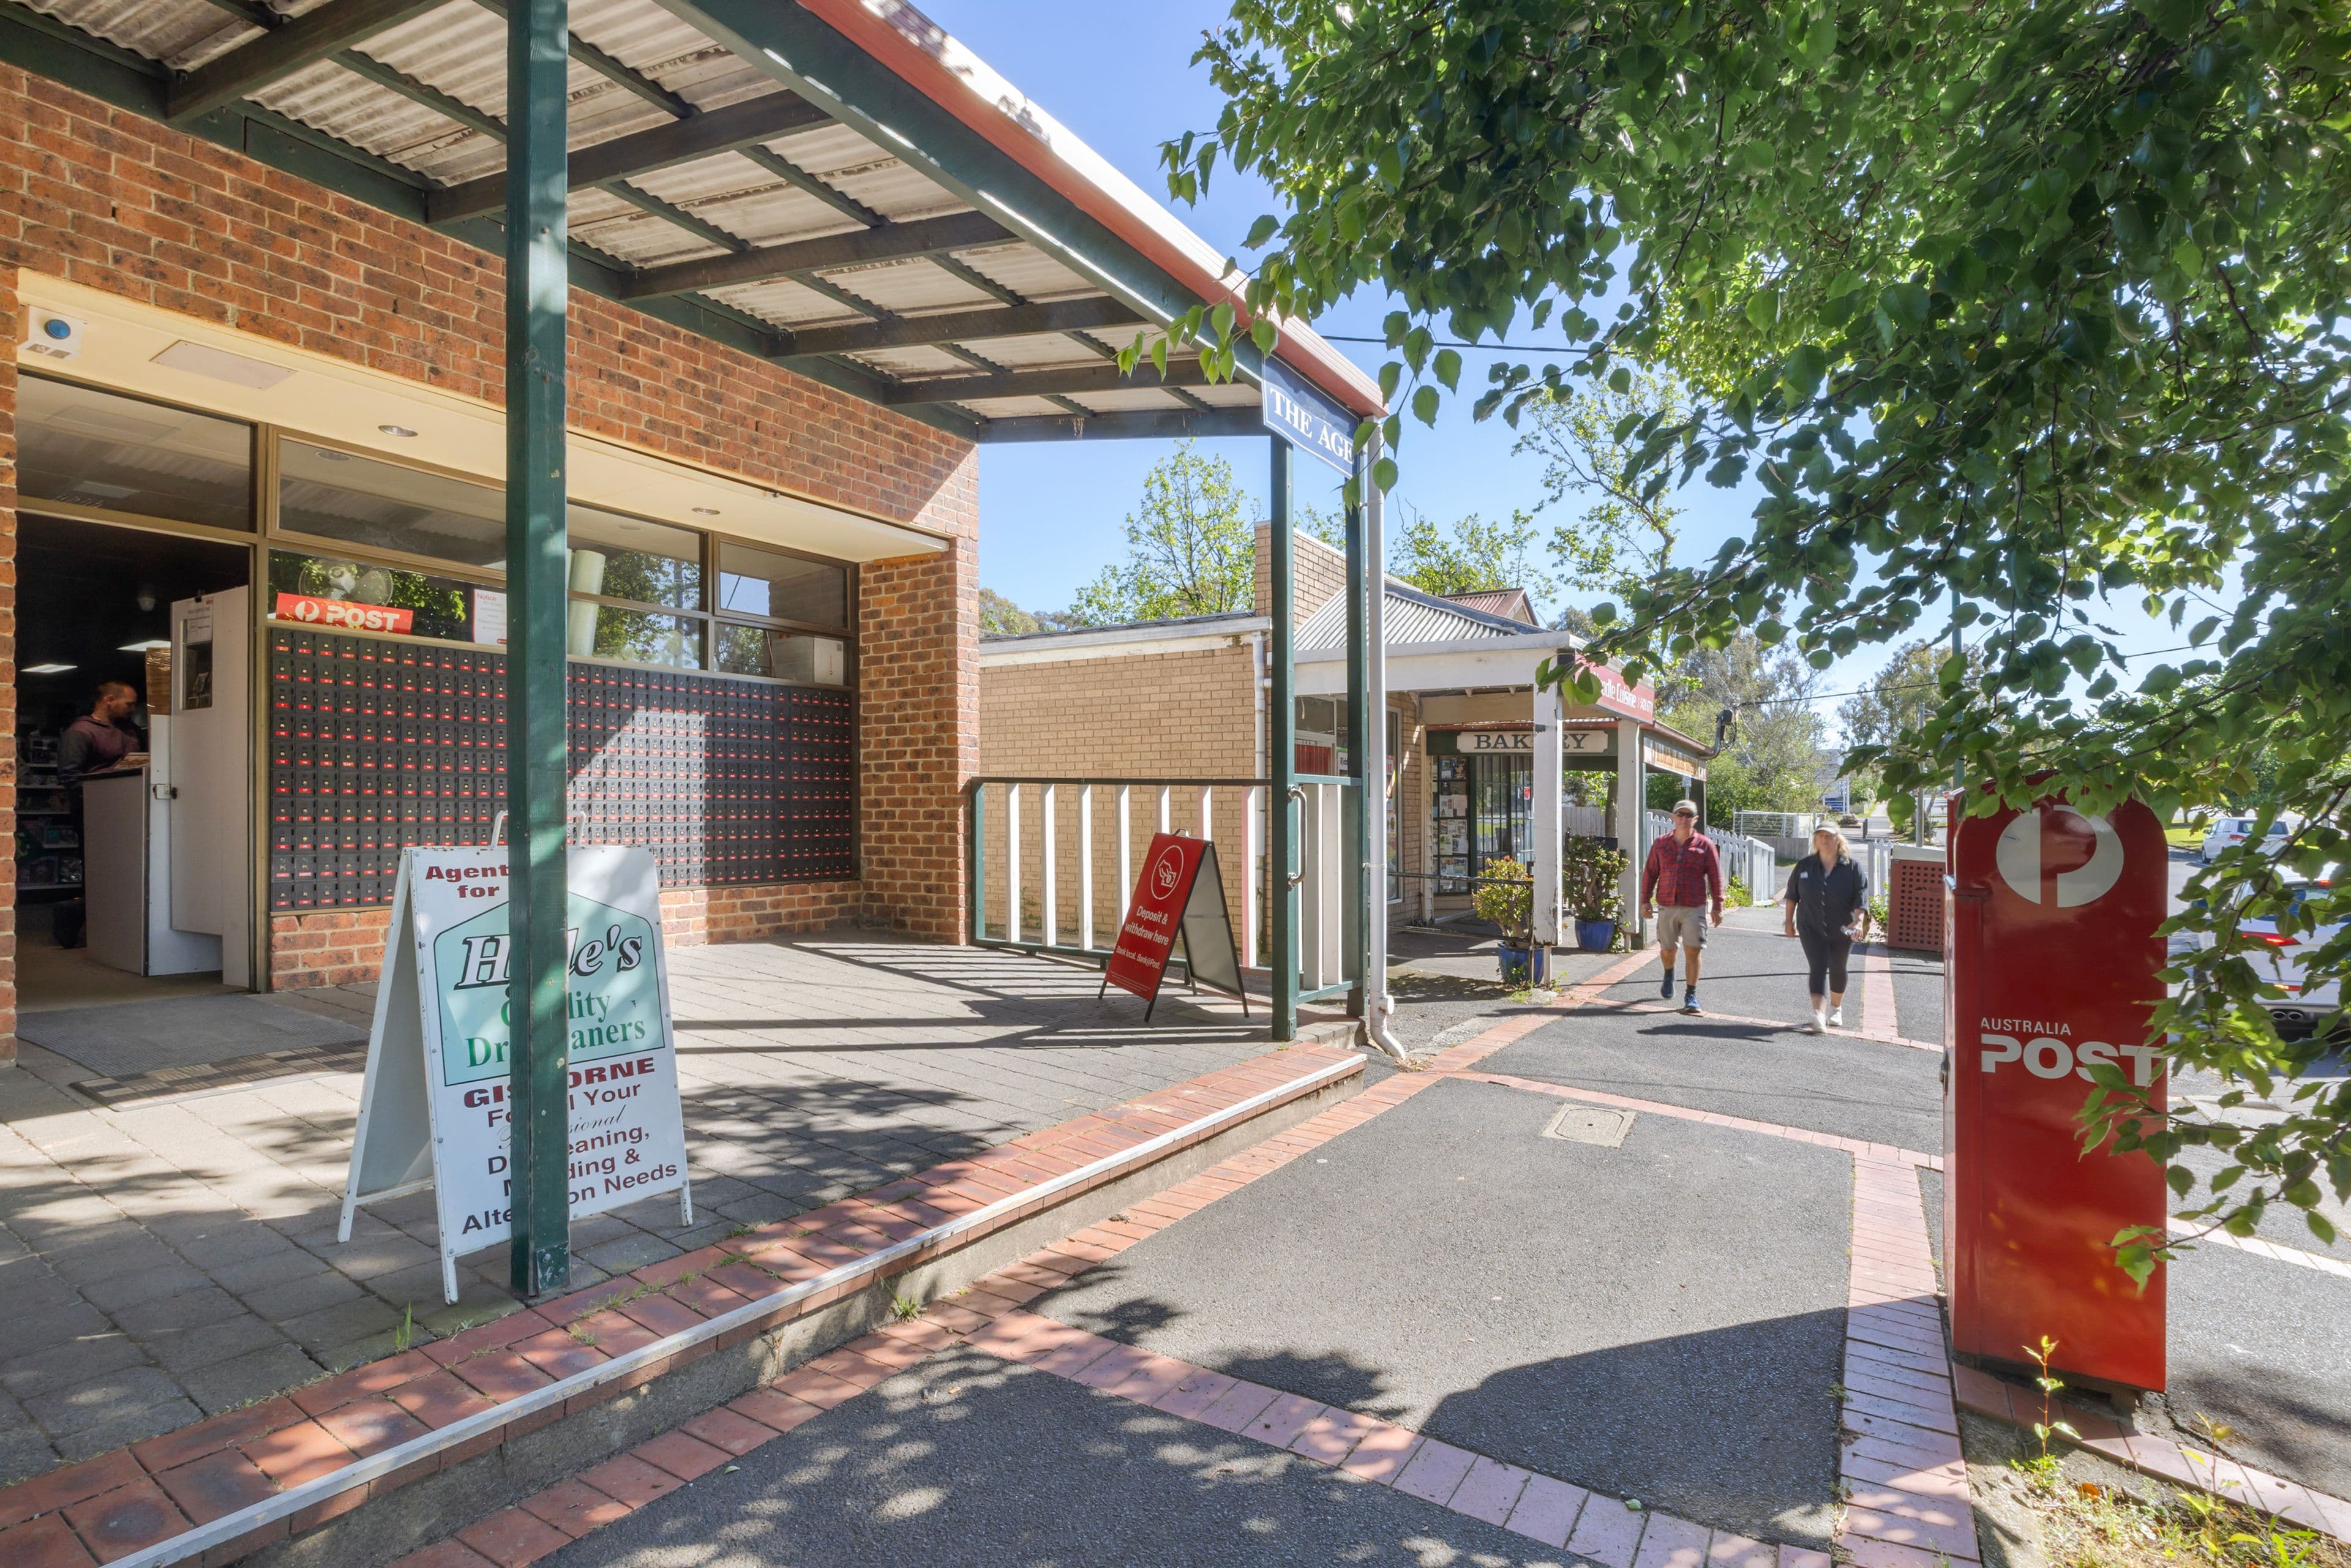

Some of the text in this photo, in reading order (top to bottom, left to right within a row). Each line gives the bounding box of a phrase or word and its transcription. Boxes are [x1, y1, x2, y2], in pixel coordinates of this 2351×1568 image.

[1270, 388, 1354, 465] THE AGE
[326, 605, 400, 631] POST
[1616, 682, 1637, 708] Cuisine
[457, 885, 500, 898] for
[1136, 906, 1168, 925] Deposit &
[1125, 922, 1169, 945] withdraw here
[1116, 945, 1127, 955] Bank
[1981, 1017, 2072, 1036] AUSTRALIA
[1981, 1033, 2168, 1087] POST
[583, 1083, 641, 1106] Your
[624, 1148, 640, 1165] &
[604, 1164, 678, 1195] Needs
